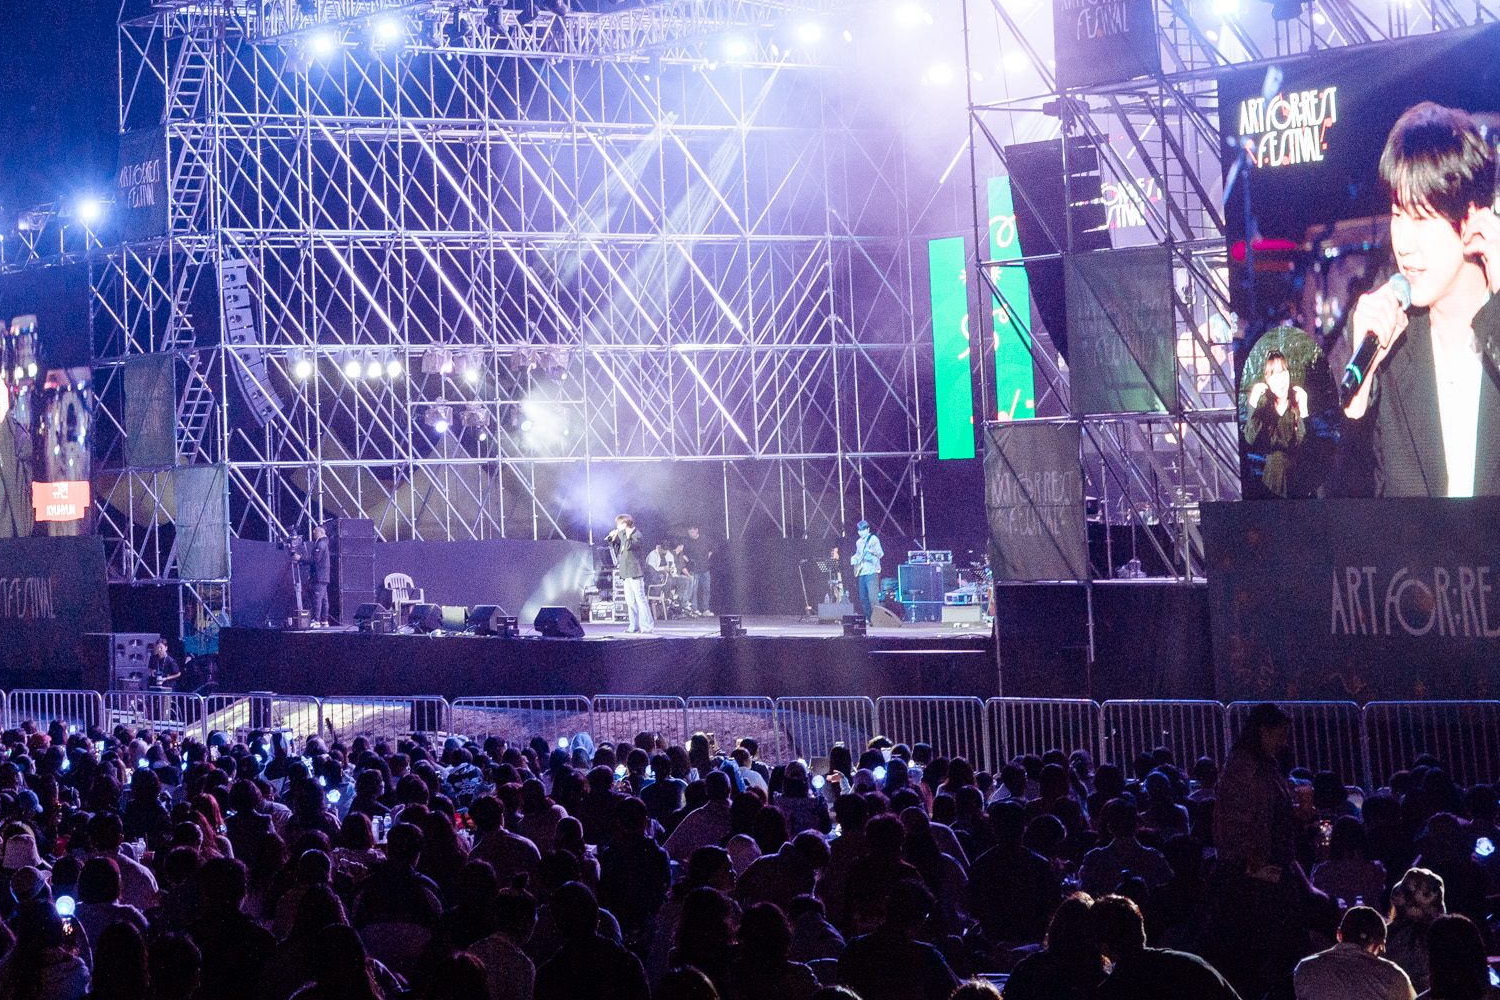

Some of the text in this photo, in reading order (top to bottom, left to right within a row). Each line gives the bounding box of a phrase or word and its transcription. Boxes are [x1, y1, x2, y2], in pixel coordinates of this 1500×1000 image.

[1077, 2, 1129, 41] FESTIVAL
[1239, 98, 1265, 135] ART
[1257, 126, 1324, 168] FESTIVAL
[1331, 566, 1378, 635] ART
